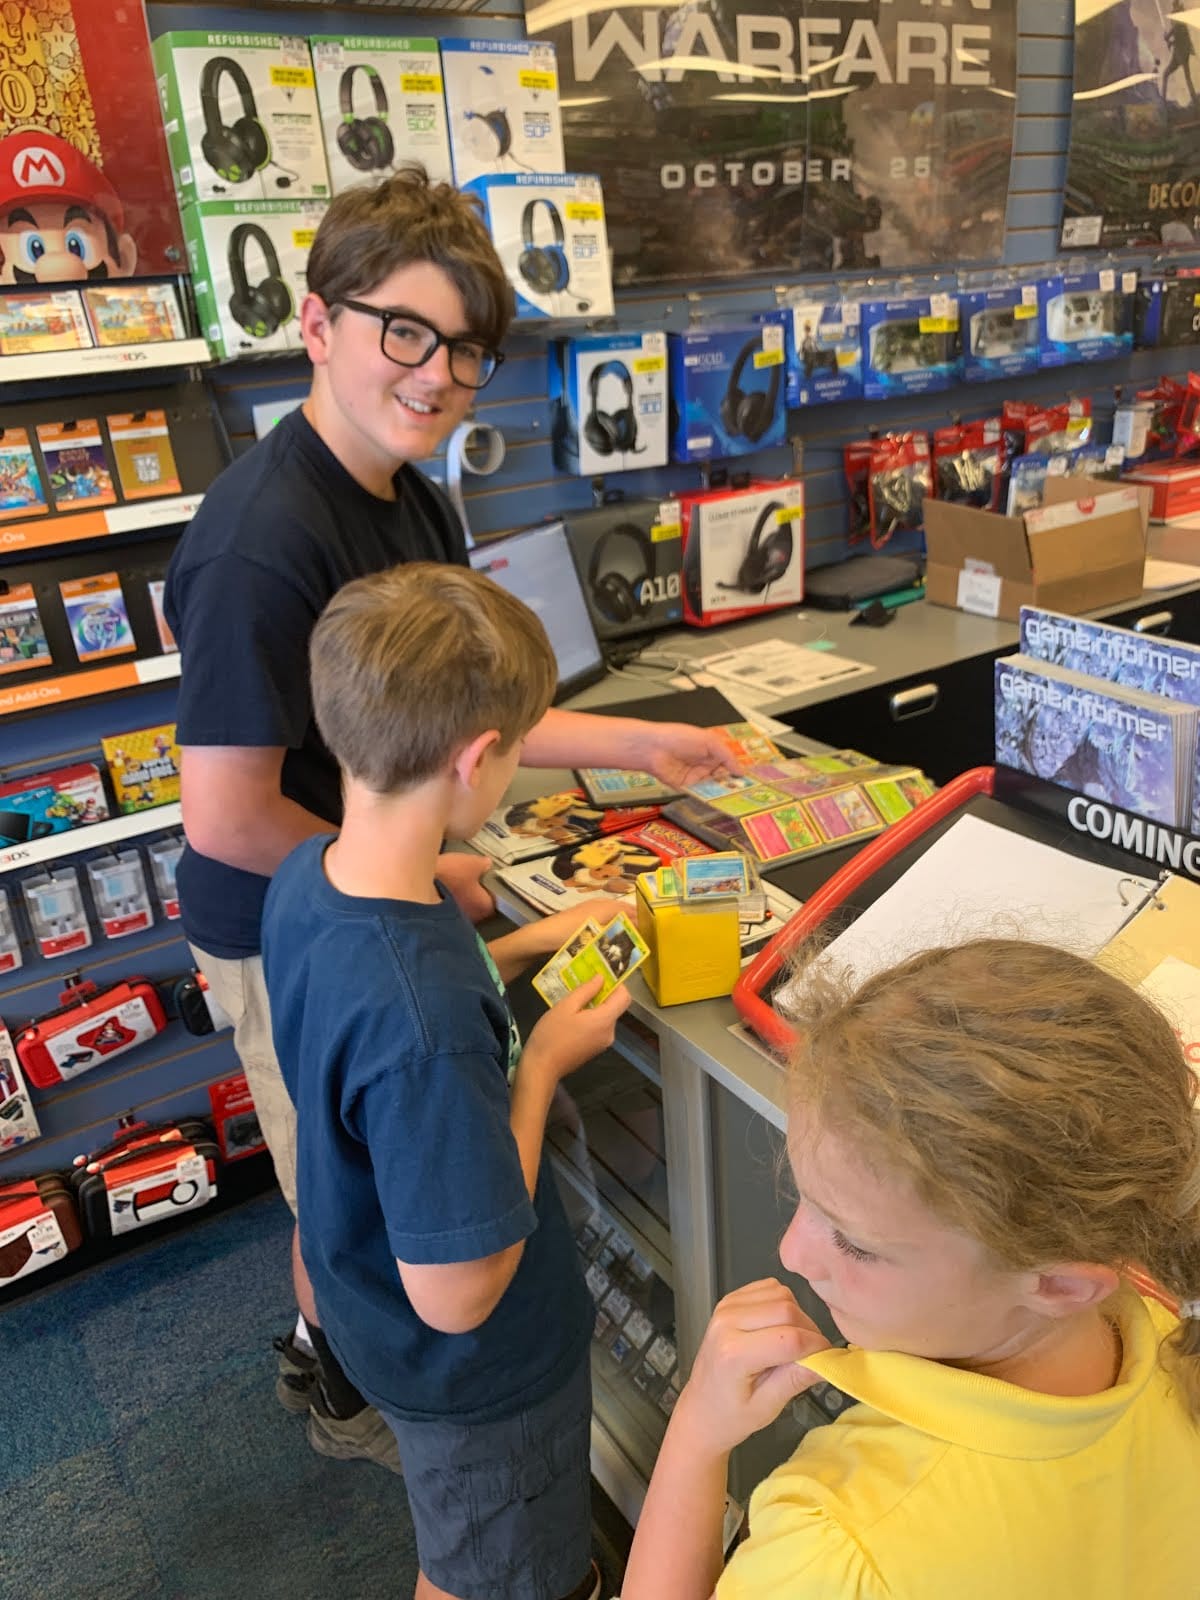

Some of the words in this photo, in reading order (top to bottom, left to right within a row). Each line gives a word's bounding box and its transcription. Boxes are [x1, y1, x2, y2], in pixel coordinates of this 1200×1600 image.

[207, 34, 280, 48] REFURBISHED
[343, 39, 410, 50] REFURBISHED
[571, 10, 991, 85] WARFARE
[660, 158, 852, 189] OCTOBER
[888, 156, 931, 179] 25
[640, 573, 681, 606] A10
[1067, 796, 1200, 879] COMING
